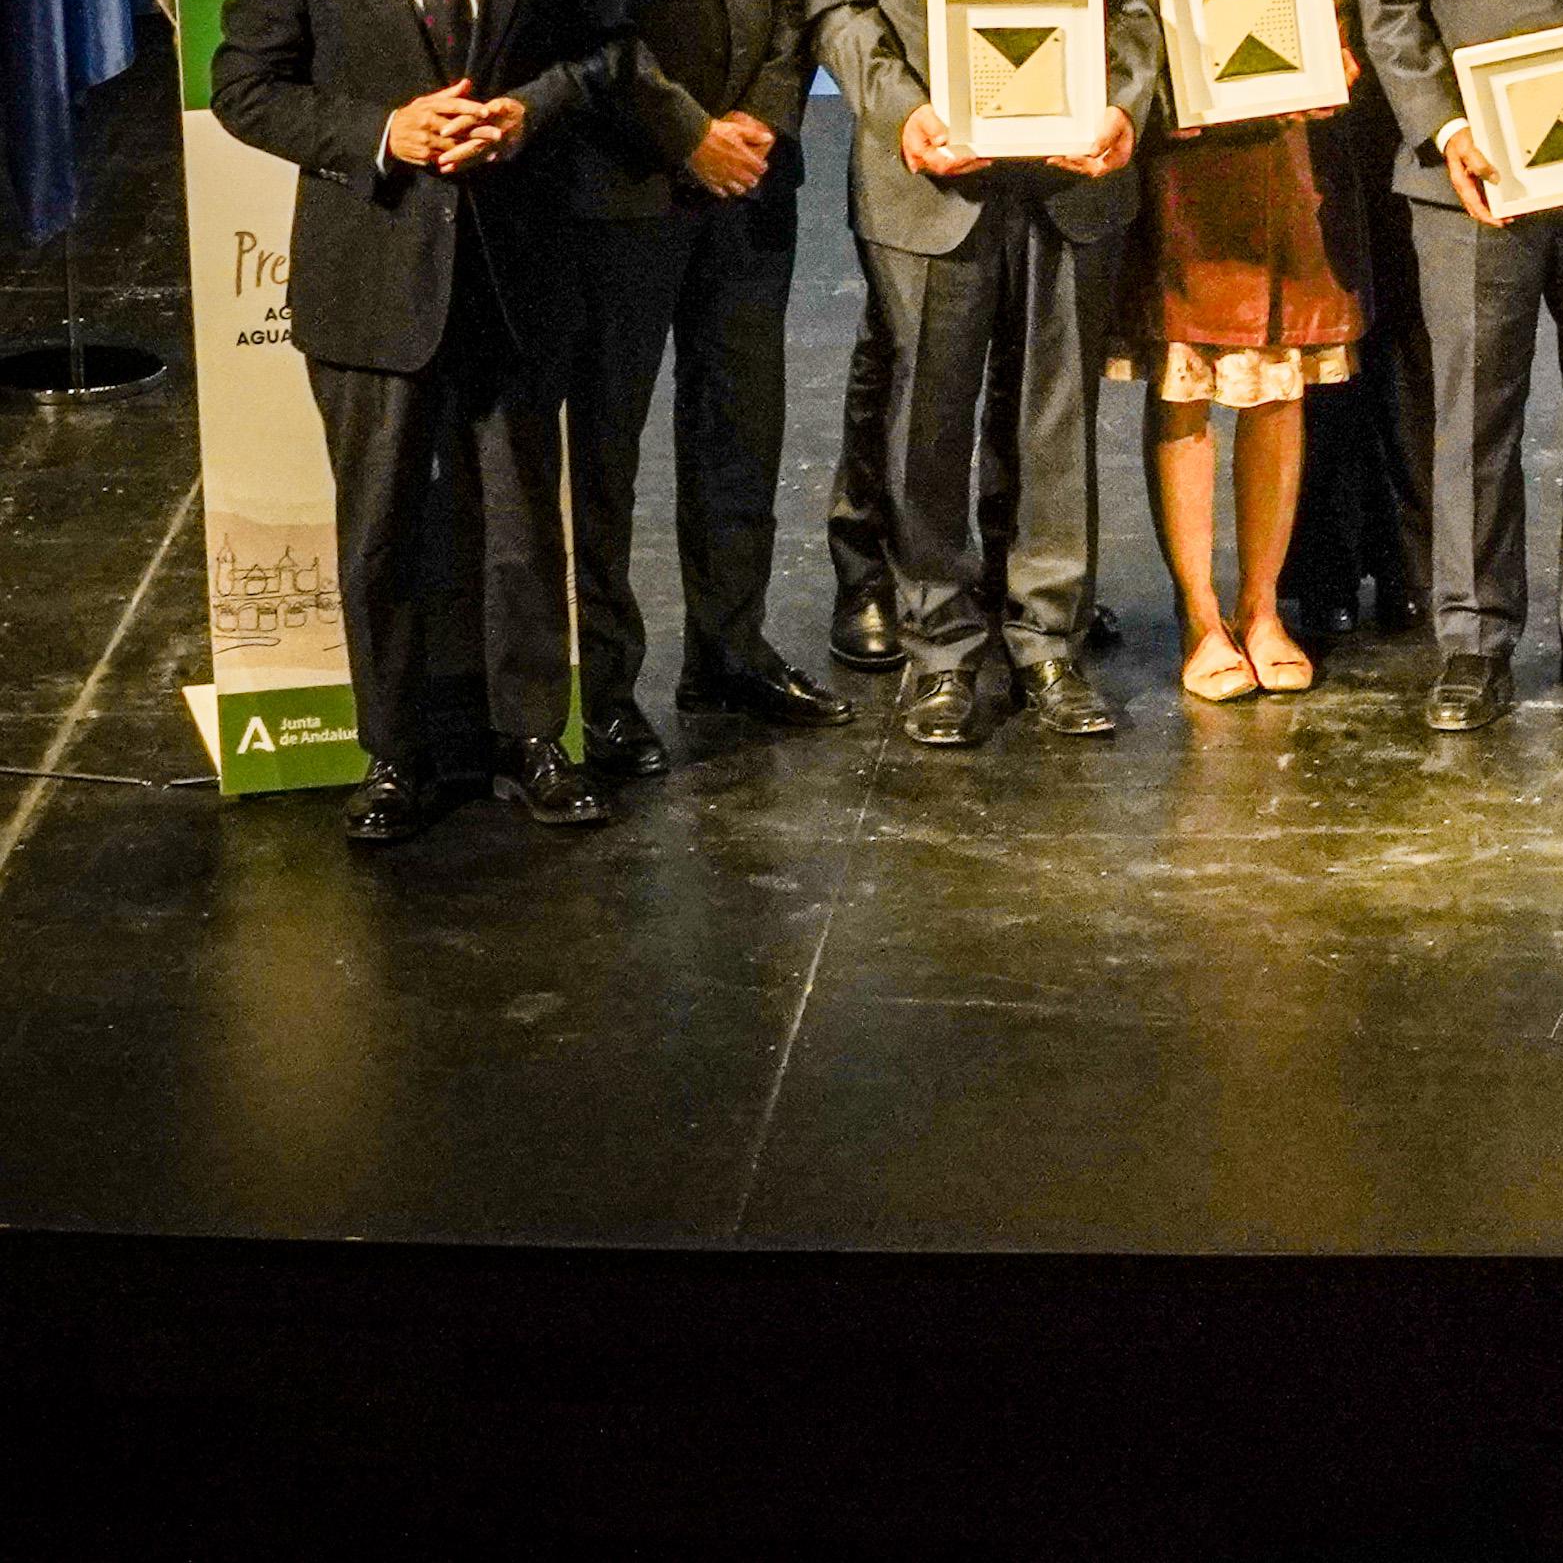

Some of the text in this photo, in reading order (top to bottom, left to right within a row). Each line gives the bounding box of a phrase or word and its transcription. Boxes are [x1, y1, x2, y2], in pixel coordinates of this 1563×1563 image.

[234, 231, 289, 297] Pre
[264, 306, 292, 321] AG
[279, 716, 321, 731] Junta
[279, 728, 359, 746] de Andaluc
